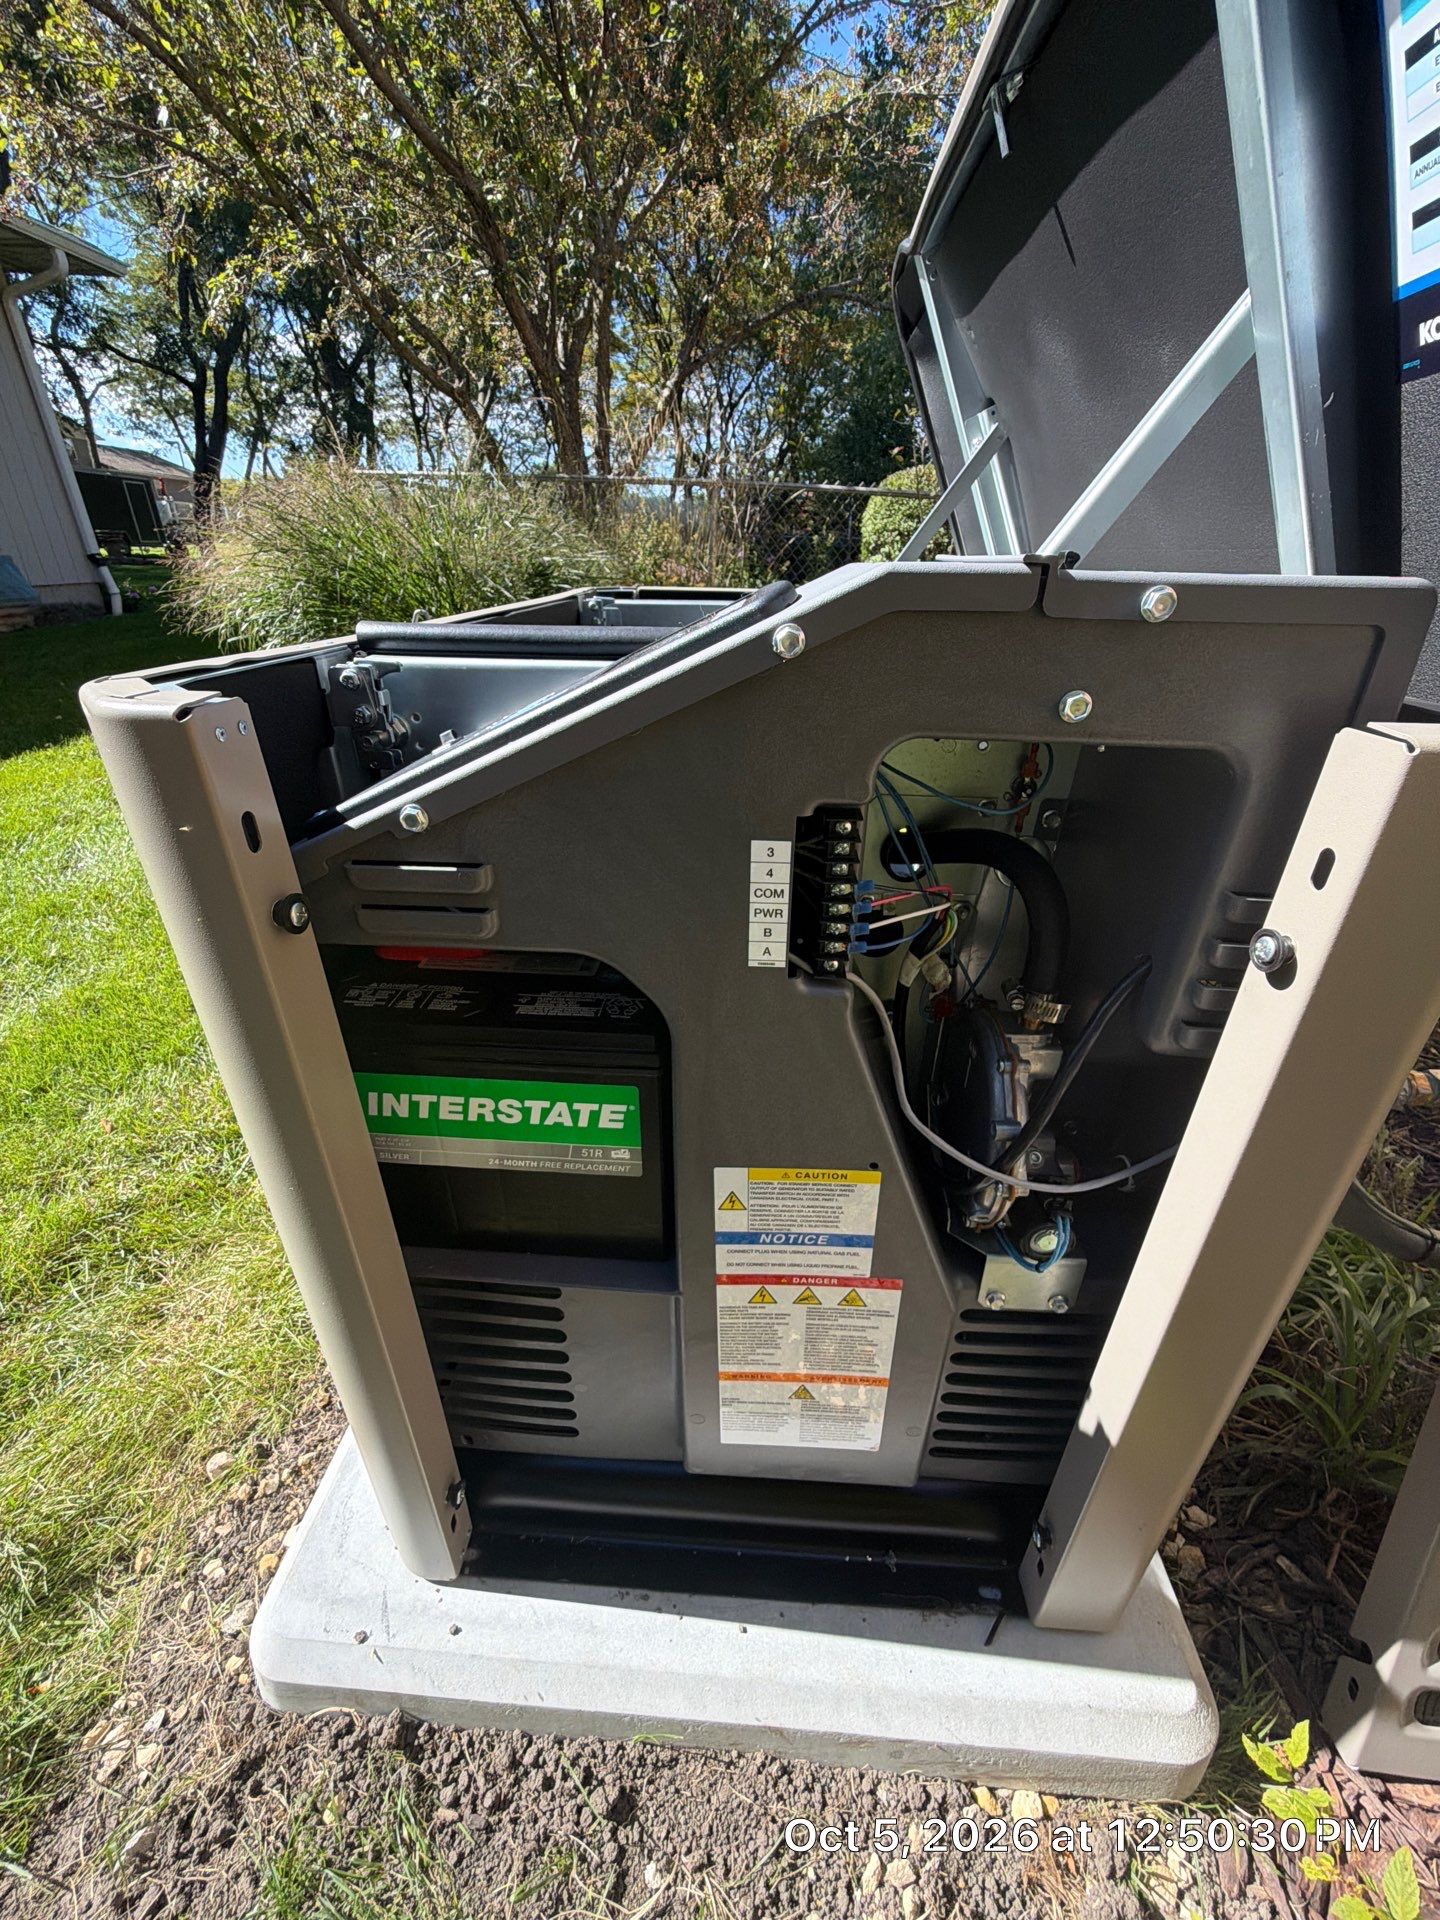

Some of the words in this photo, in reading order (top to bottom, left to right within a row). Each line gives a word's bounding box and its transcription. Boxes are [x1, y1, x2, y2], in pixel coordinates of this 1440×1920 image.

[767, 848, 774, 857] 3
[766, 868, 773, 878] 4
[754, 888, 784, 898] COM
[754, 908, 784, 918] PWR
[764, 928, 772, 937] B
[763, 947, 771, 956] A
[368, 1092, 628, 1130] INTERSTATE
[581, 1149, 603, 1158] 51R
[488, 1158, 537, 1167] 24-MONTH
[564, 1162, 632, 1172] REPLACEMENT
[760, 1234, 828, 1244] NOTICE
